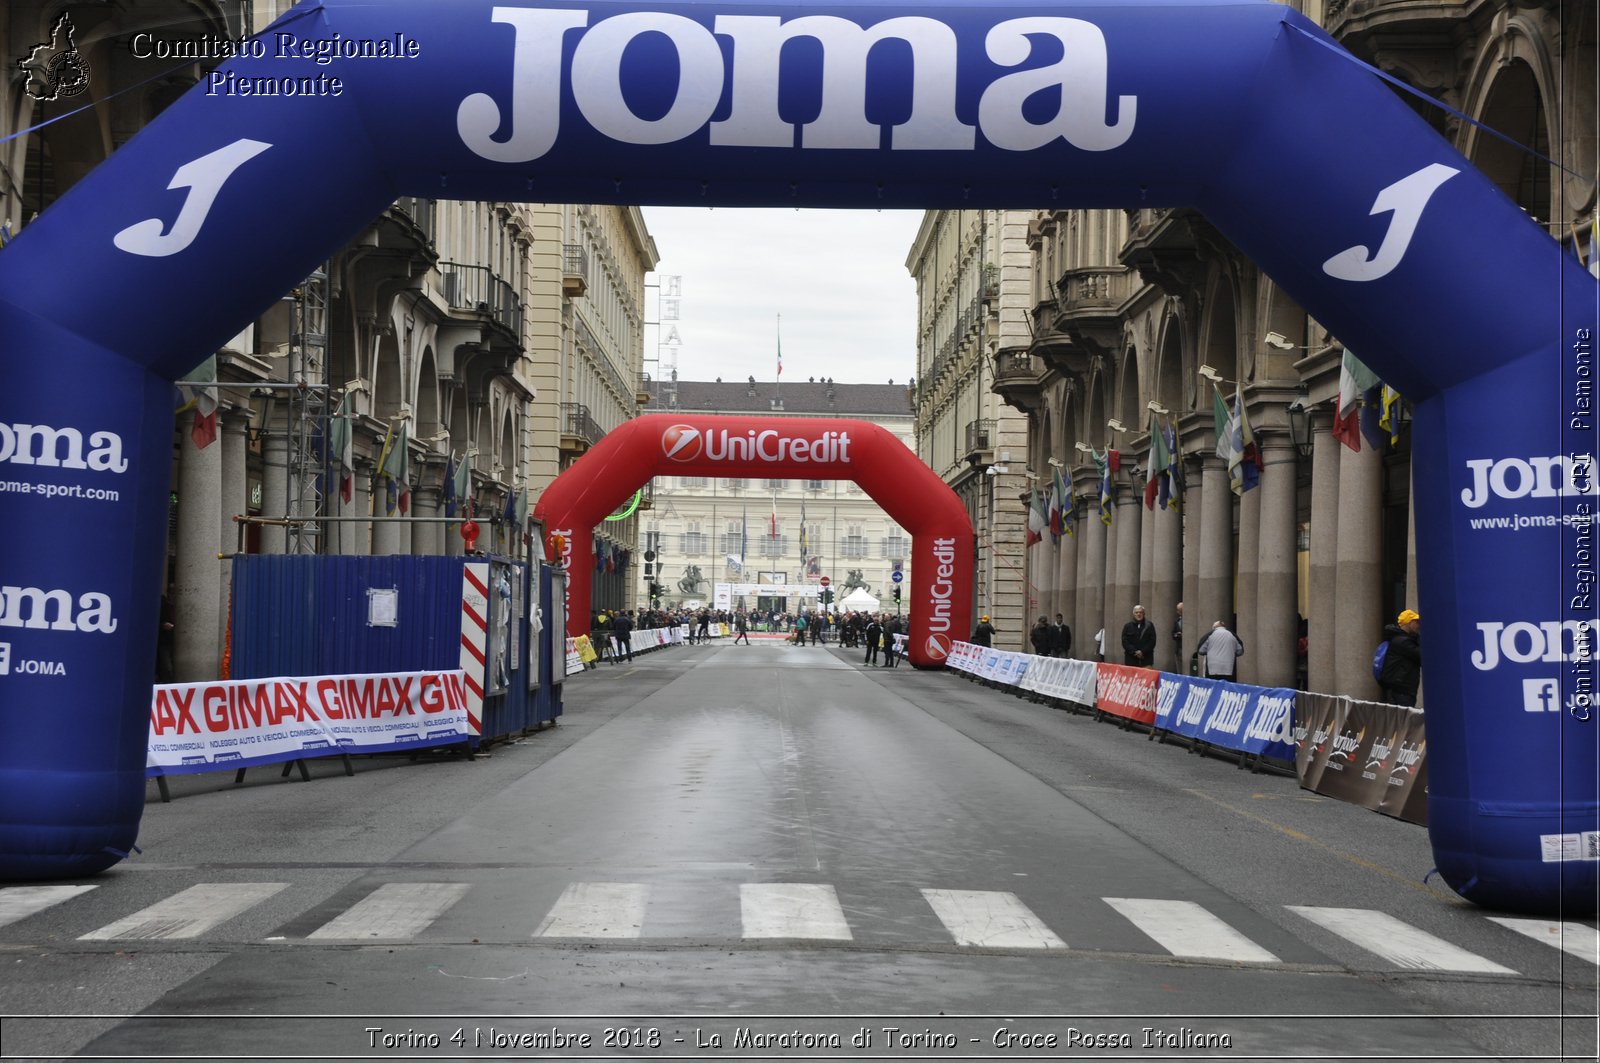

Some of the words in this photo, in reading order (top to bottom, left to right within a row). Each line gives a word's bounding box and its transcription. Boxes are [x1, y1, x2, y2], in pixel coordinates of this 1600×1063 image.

[457, 7, 1138, 163] Joma
[705, 429, 851, 463] UniCredit
[929, 538, 955, 632] UniCredit
[15, 660, 66, 676] JOMA
[203, 682, 320, 733] GIMAX
[317, 675, 415, 720] GIMAX
[209, 738, 238, 748] NOLEGGIO
[239, 736, 256, 745] AUTO
[257, 735, 262, 743] E
[263, 732, 288, 742] VEICOLI
[385, 721, 419, 732] COMMERCIALI
[424, 717, 454, 727] NOLEGGIO
